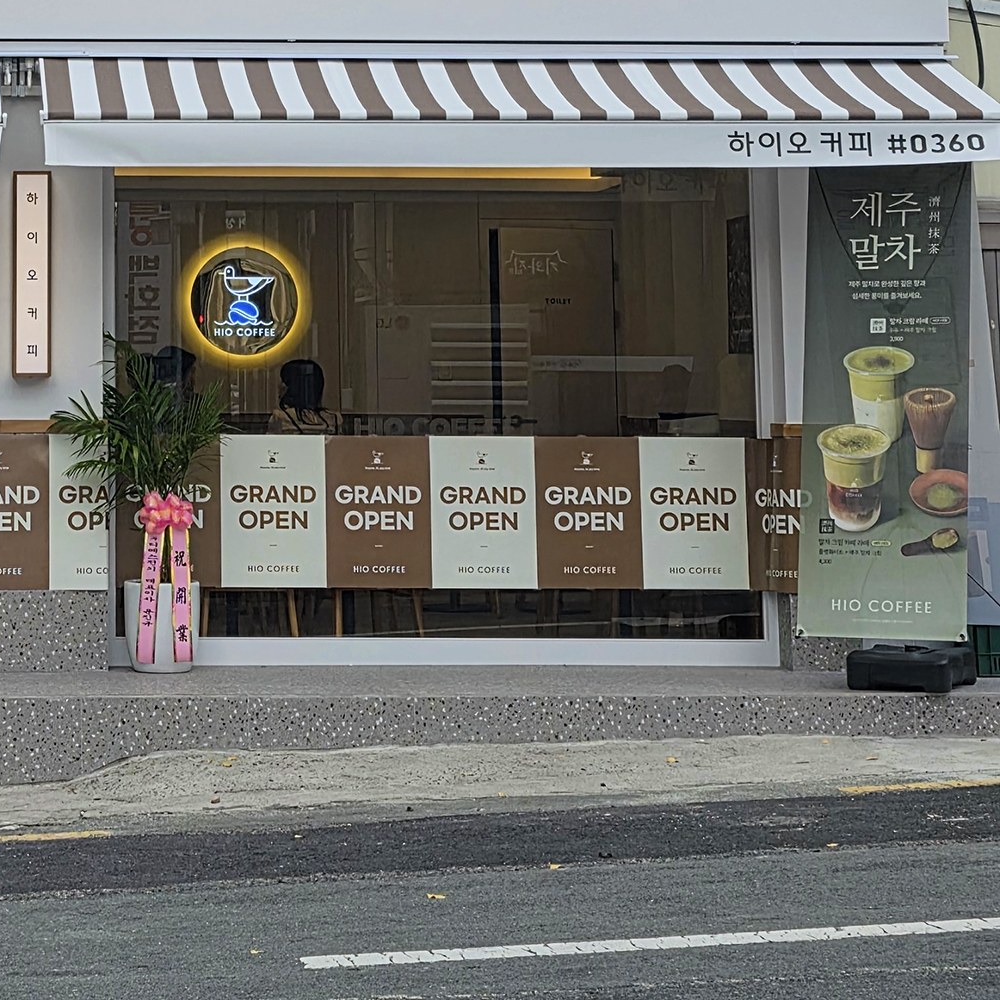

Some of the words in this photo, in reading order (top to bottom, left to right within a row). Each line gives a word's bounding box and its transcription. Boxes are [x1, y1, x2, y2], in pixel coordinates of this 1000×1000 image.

[887, 132, 986, 155] #0360
[850, 191, 922, 228] 제주
[849, 233, 922, 271] 말차
[26, 192, 39, 357] 하이오커피
[545, 297, 572, 305] TOILET
[214, 327, 233, 337] HIO
[236, 327, 276, 337] COFFEE
[58, 484, 109, 504] GRA
[229, 484, 317, 504] GRAND
[334, 485, 422, 504] GRAND
[439, 485, 527, 505] GRAND
[544, 486, 632, 505] GRAND
[649, 486, 737, 506] GRAND
[238, 510, 309, 530] OPEN
[343, 511, 414, 531] OPEN
[449, 511, 518, 531] OPEN
[553, 511, 624, 532] OPEN
[659, 512, 730, 532] OPEN
[831, 598, 861, 611] HIO
[868, 599, 932, 613] COFFEE
